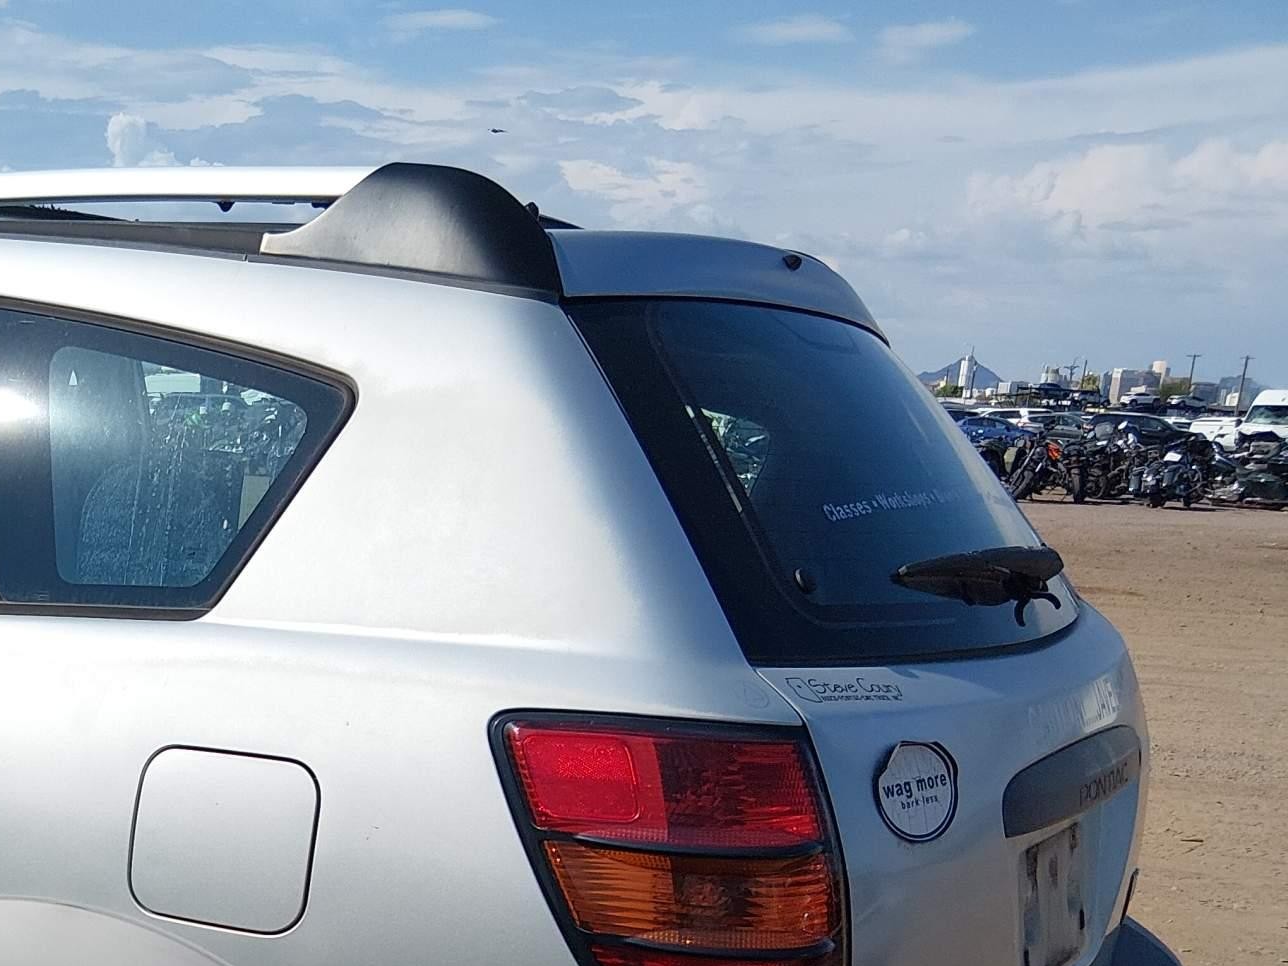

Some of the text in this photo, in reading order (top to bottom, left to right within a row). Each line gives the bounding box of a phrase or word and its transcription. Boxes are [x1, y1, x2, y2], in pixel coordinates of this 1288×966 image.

[823, 500, 873, 522] Classes
[808, 679, 858, 694] Steve
[882, 773, 947, 799] wag more
[1080, 762, 1129, 807] PONTIAC
[900, 795, 939, 810] bark less
